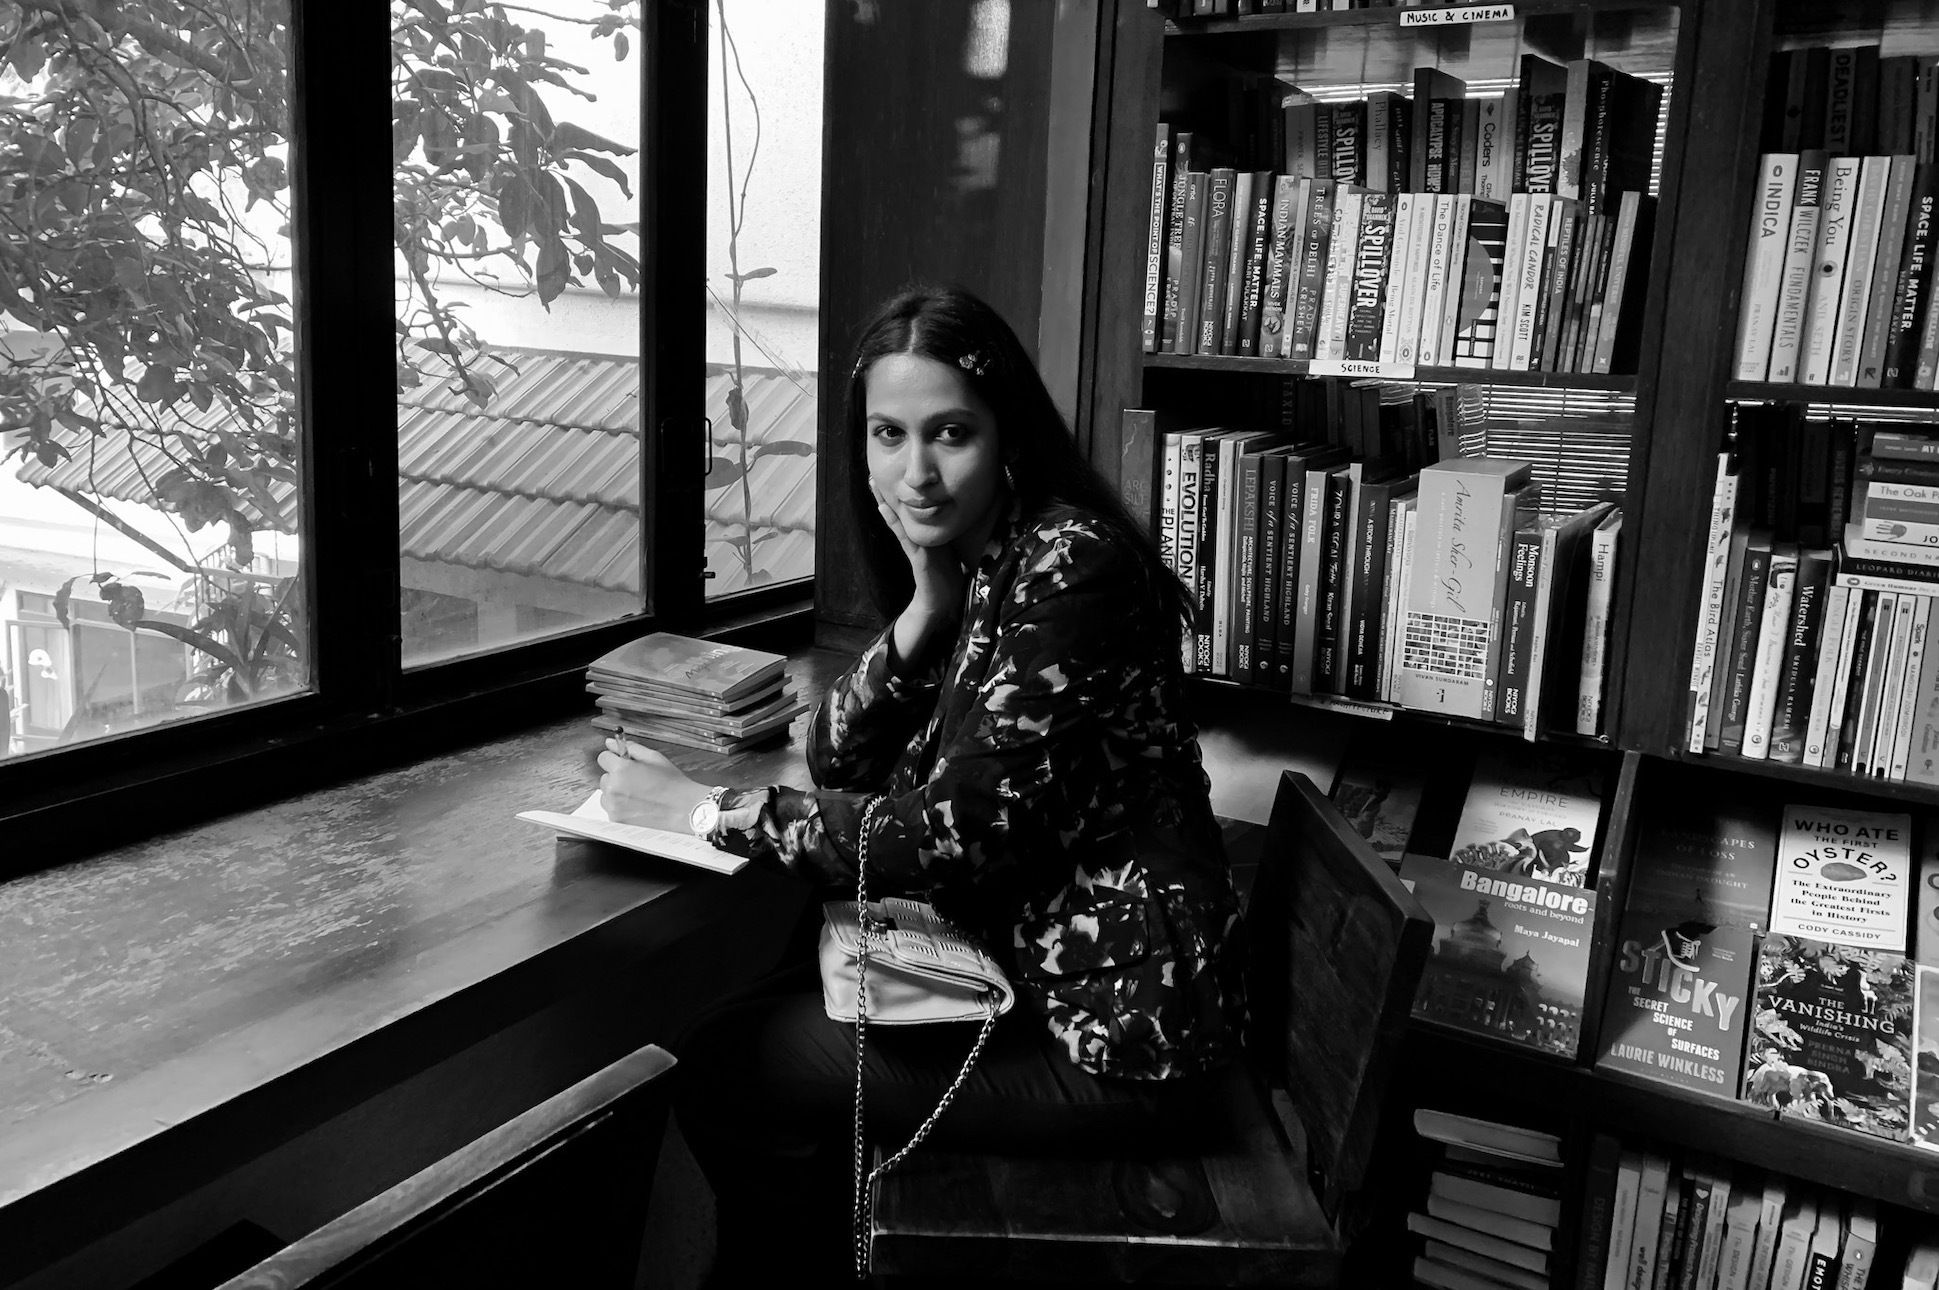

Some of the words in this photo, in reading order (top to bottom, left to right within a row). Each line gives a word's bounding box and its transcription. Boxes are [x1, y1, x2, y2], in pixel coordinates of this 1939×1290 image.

[1407, 12, 1437, 23] MUSIC
[1445, 11, 1455, 21] &
[1462, 8, 1509, 20] CINEMA
[1831, 54, 1851, 143] DEADLIEST
[1318, 115, 1328, 158] LIFESTYLE
[1372, 101, 1387, 151] Phallacy
[1428, 103, 1444, 159] APOCALYPSE
[1482, 122, 1496, 167] Coders
[1155, 165, 1164, 197] WHAT'S
[1801, 169, 1821, 206] FRANK
[1825, 166, 1852, 212] Being
[1175, 174, 1187, 219] JUNGLE
[1211, 178, 1228, 218] FLORA
[1313, 186, 1326, 226] TREES
[1439, 202, 1449, 220] The
[1761, 182, 1783, 239] INDICA
[1153, 217, 1161, 241] POINT
[1256, 198, 1267, 235] SPACE.
[1277, 199, 1290, 238] INDIAN
[1528, 204, 1545, 250] RADICAL
[1825, 215, 1845, 246] You
[1915, 196, 1934, 240] SPACE.
[1311, 230, 1318, 239] OF
[1435, 221, 1447, 251] Dance
[1561, 217, 1573, 256] REPTILES
[1793, 210, 1814, 254] WILCZEK
[1152, 242, 1160, 254] OF
[1254, 237, 1263, 263] LIFE.
[1306, 241, 1319, 278] DELHI
[1433, 256, 1443, 268] of
[1559, 256, 1566, 267] OF
[1910, 243, 1926, 275] LIFE.
[1270, 240, 1285, 299] MAMMALS
[1356, 224, 1386, 308] SPILLOVER
[1430, 269, 1442, 291] Life
[1523, 250, 1539, 290] CANDOR
[1145, 255, 1160, 315] SCIENCE?
[1250, 265, 1261, 309] MATTER.
[1554, 269, 1565, 294] INDIA
[1172, 279, 1180, 318] PRADIP
[1296, 286, 1307, 334] KRISHEN
[1306, 289, 1317, 331] PRADIP
[1521, 303, 1532, 318] KIM
[1779, 266, 1806, 349] FUNDAMENTALS
[1900, 278, 1920, 332] MATTER.
[1385, 308, 1396, 335] Mortal
[1518, 320, 1530, 341] SCOTT
[1341, 363, 1380, 374] SCIENCE
[1202, 452, 1217, 493] Radha
[1243, 468, 1257, 532] LEPAKSHI
[1268, 481, 1276, 506] VOICE
[1291, 482, 1299, 508] VOICE
[1309, 487, 1319, 517] FRIDA
[1450, 479, 1472, 532] Amrita
[1880, 485, 1900, 497] The
[1903, 488, 1929, 499] Oak
[1161, 507, 1175, 515] THE
[1180, 471, 1197, 579] EVOLUTION
[1266, 510, 1277, 521] of
[1288, 512, 1299, 523] of
[1160, 516, 1175, 569] PLANE
[1307, 520, 1317, 544] FOLK
[1365, 524, 1373, 543] STORY
[1265, 530, 1274, 575] SENTIENT
[1286, 532, 1296, 577] SENTIENT
[1363, 543, 1372, 574] THROUGH
[1514, 543, 1529, 582] Feelings
[1525, 544, 1540, 587] Monsoon
[1595, 543, 1610, 583] Hampi
[1864, 548, 1913, 560] SECOND
[1441, 537, 1472, 613] Sher-Gil
[1856, 564, 1898, 575] LEOPARD
[1262, 577, 1272, 622] HIGHLAND
[1283, 580, 1293, 625] HIGHLAND
[1326, 592, 1335, 611] Kiran
[1709, 580, 1722, 602] The
[1707, 603, 1720, 625] Bird
[1793, 585, 1815, 647] Watershed
[1703, 627, 1717, 657] Atlas
[1913, 623, 1925, 644] Spark
[1197, 634, 1205, 666] BOOKS
[1203, 634, 1211, 667] NIYOGI
[1415, 673, 1433, 682] VIVAN
[1434, 675, 1469, 687] SUNDARAM
[1504, 687, 1512, 714] BOOKS
[1510, 688, 1519, 715] NIYOGI
[1499, 787, 1569, 809] EMPIRE
[1794, 819, 1849, 838] WHO
[1855, 825, 1900, 842] ATE
[1815, 835, 1838, 845] THE
[1841, 837, 1879, 849] FIRST
[1793, 846, 1898, 885] OYSTER?
[1792, 880, 1813, 889] The
[1815, 882, 1893, 900] Extraordinary
[1801, 889, 1837, 903] People
[1841, 895, 1881, 907] Behind
[1503, 900, 1528, 912] roots
[1529, 905, 1549, 918] and
[1549, 910, 1585, 925] beyond
[1790, 898, 1809, 907] the
[1811, 900, 1857, 914] Greatest
[1859, 907, 1891, 917] Firsts
[1811, 909, 1824, 918] in
[1827, 912, 1868, 924] History
[1514, 924, 1540, 938] Maya
[1540, 930, 1580, 949] Jayapal
[1797, 923, 1829, 933] CODY
[1832, 927, 1882, 941] CASSIDY
[1619, 940, 1740, 1032] STICKY
[1628, 986, 1641, 996] THE
[1633, 996, 1669, 1014] SECRET
[1767, 996, 1896, 1035] VANISHING
[1818, 996, 1845, 1010] THE
[1653, 1011, 1694, 1032] SCIENCE
[1667, 1027, 1677, 1037] OF
[1799, 1023, 1833, 1037] Wildlife
[1833, 1031, 1861, 1043] Crisis
[1815, 1020, 1845, 1032] India's
[1610, 1042, 1655, 1065] LAURIE
[1657, 1052, 1725, 1085] WINKLESS
[1671, 1038, 1721, 1061] SURFACES
